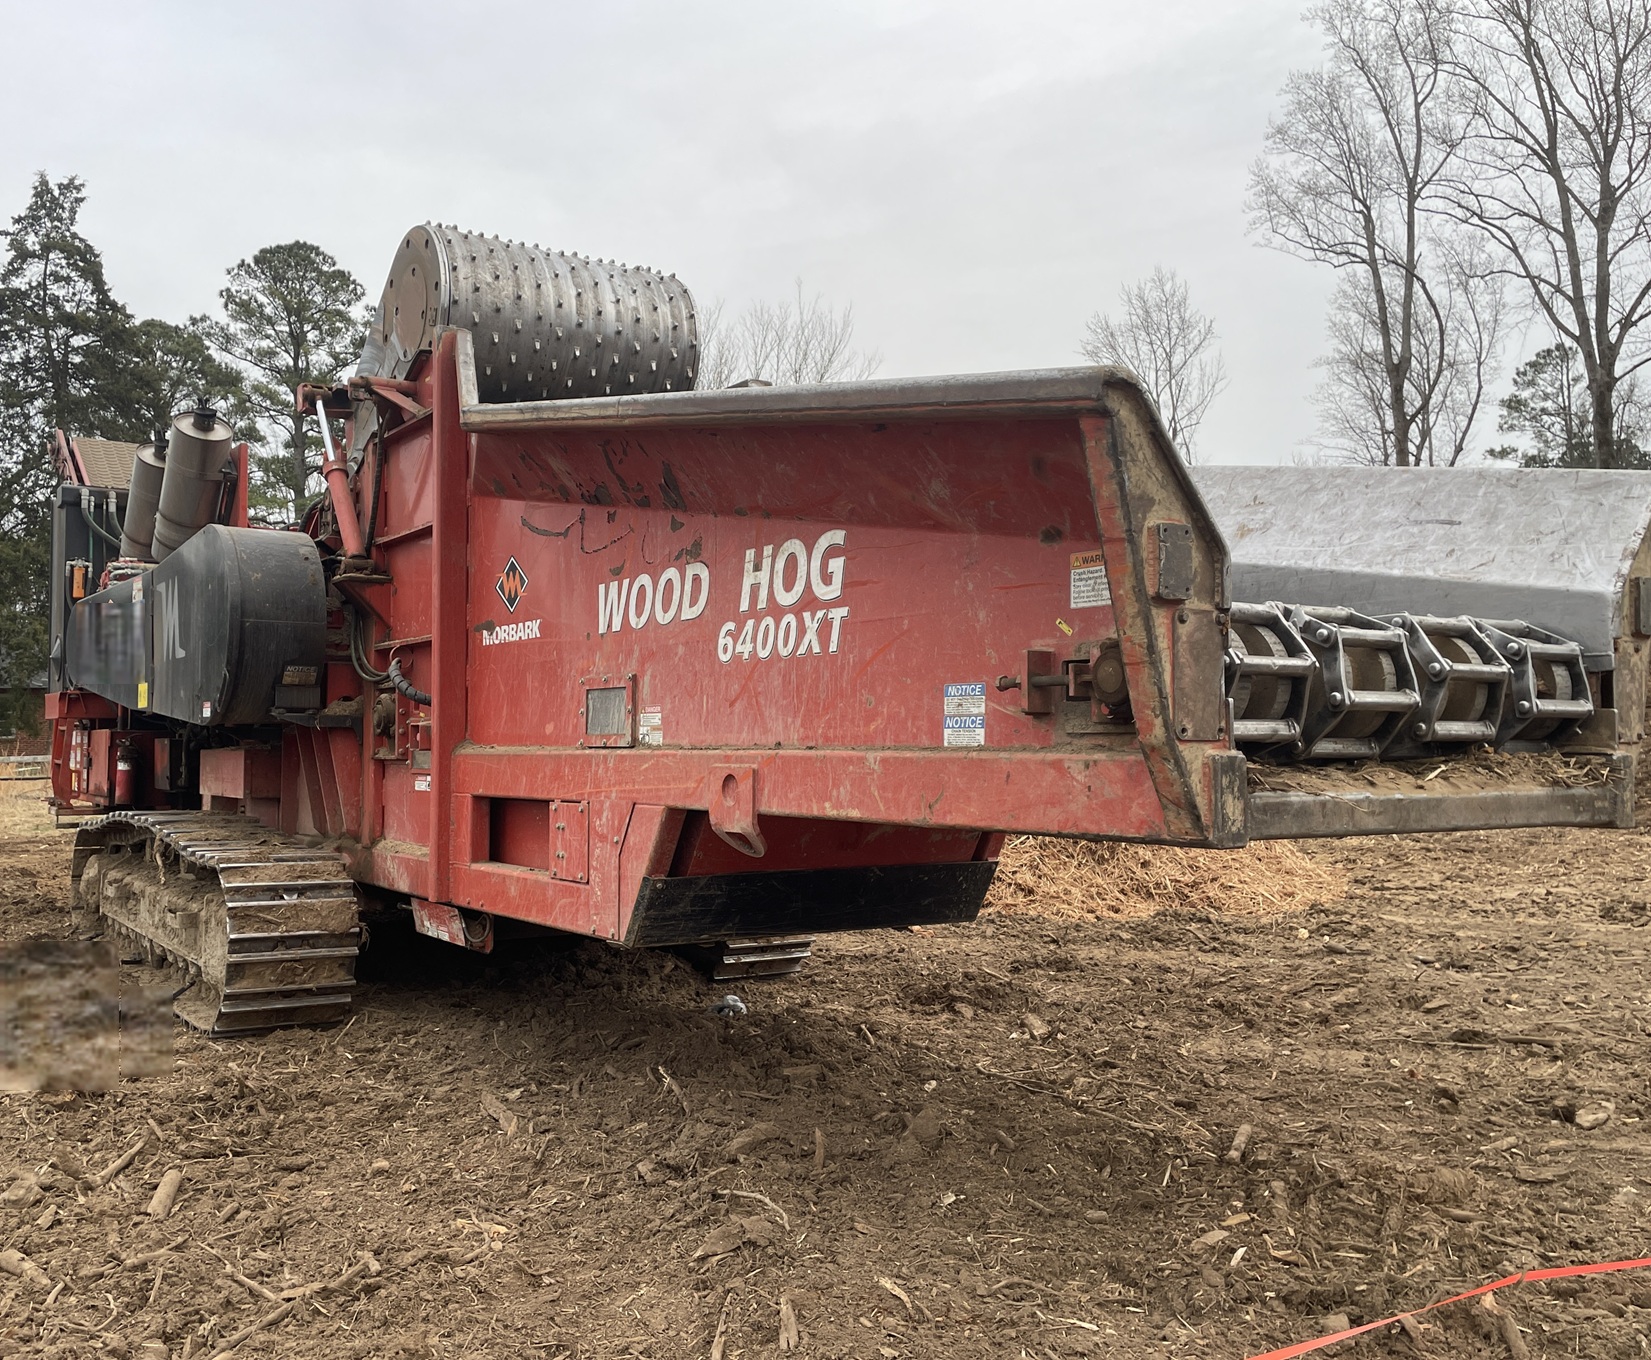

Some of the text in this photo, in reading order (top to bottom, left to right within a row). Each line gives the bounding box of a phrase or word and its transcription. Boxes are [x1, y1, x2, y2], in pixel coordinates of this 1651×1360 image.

[598, 529, 847, 635] WOOD HOG
[482, 619, 541, 646] MORBARK
[717, 606, 850, 664] 6400XT
[947, 684, 982, 696] NOTICE
[945, 716, 984, 728] NOTICE
